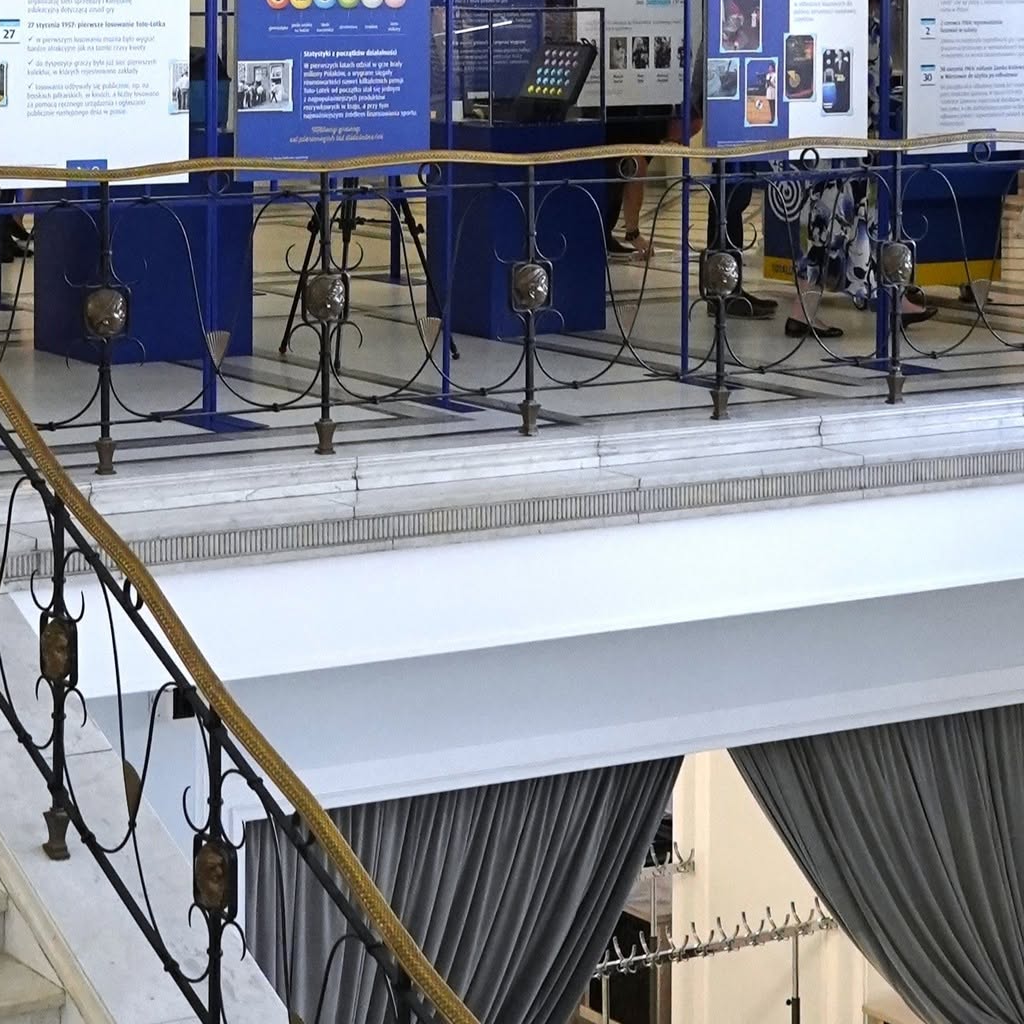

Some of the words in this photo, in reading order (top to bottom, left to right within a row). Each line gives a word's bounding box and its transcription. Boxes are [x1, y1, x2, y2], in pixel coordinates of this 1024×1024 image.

[78, 21, 104, 29] pierwsze
[3, 29, 16, 40] 27
[925, 26, 931, 36] 2
[923, 73, 933, 82] 30
